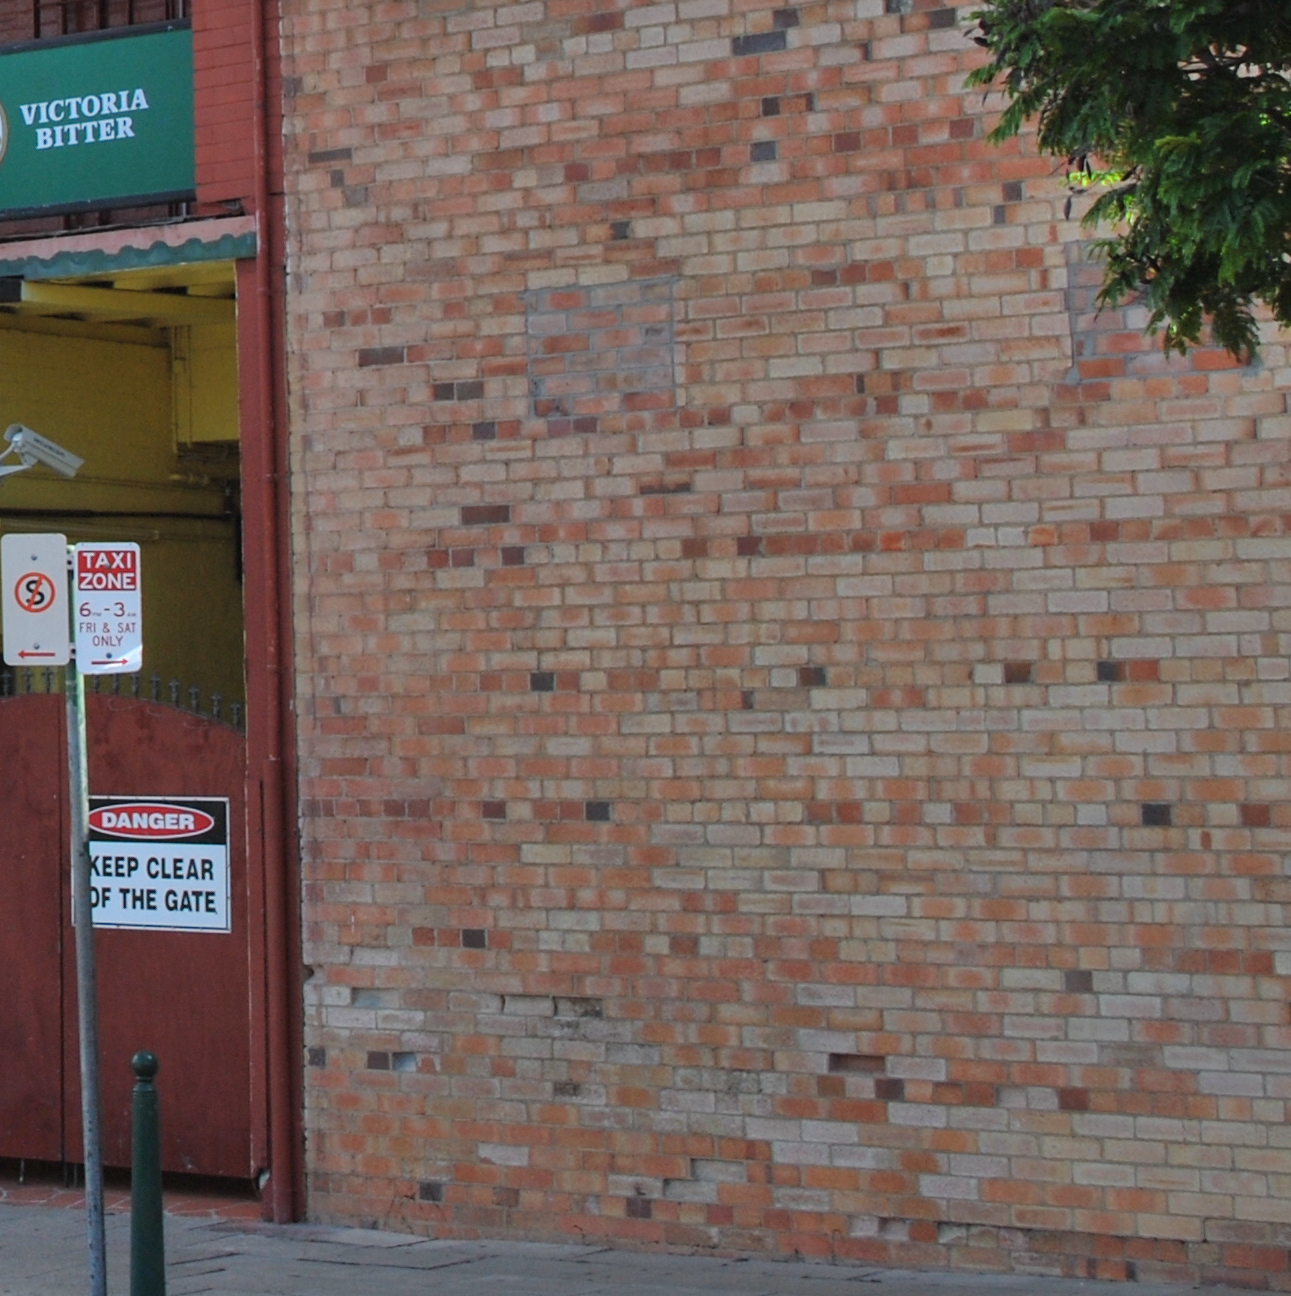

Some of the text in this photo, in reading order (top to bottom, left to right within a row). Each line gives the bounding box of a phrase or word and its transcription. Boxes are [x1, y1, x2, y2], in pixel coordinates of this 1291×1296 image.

[20, 88, 149, 125] VICTORIA
[36, 117, 135, 150] BITTER
[82, 552, 132, 569] TAXI
[79, 572, 136, 590] ZONE
[79, 622, 137, 634] FRI & SAT
[92, 634, 124, 647] ONLY
[101, 811, 195, 830] DANGER
[146, 856, 215, 881] CLEAR
[119, 887, 158, 911] THE
[164, 889, 217, 913] GATE
